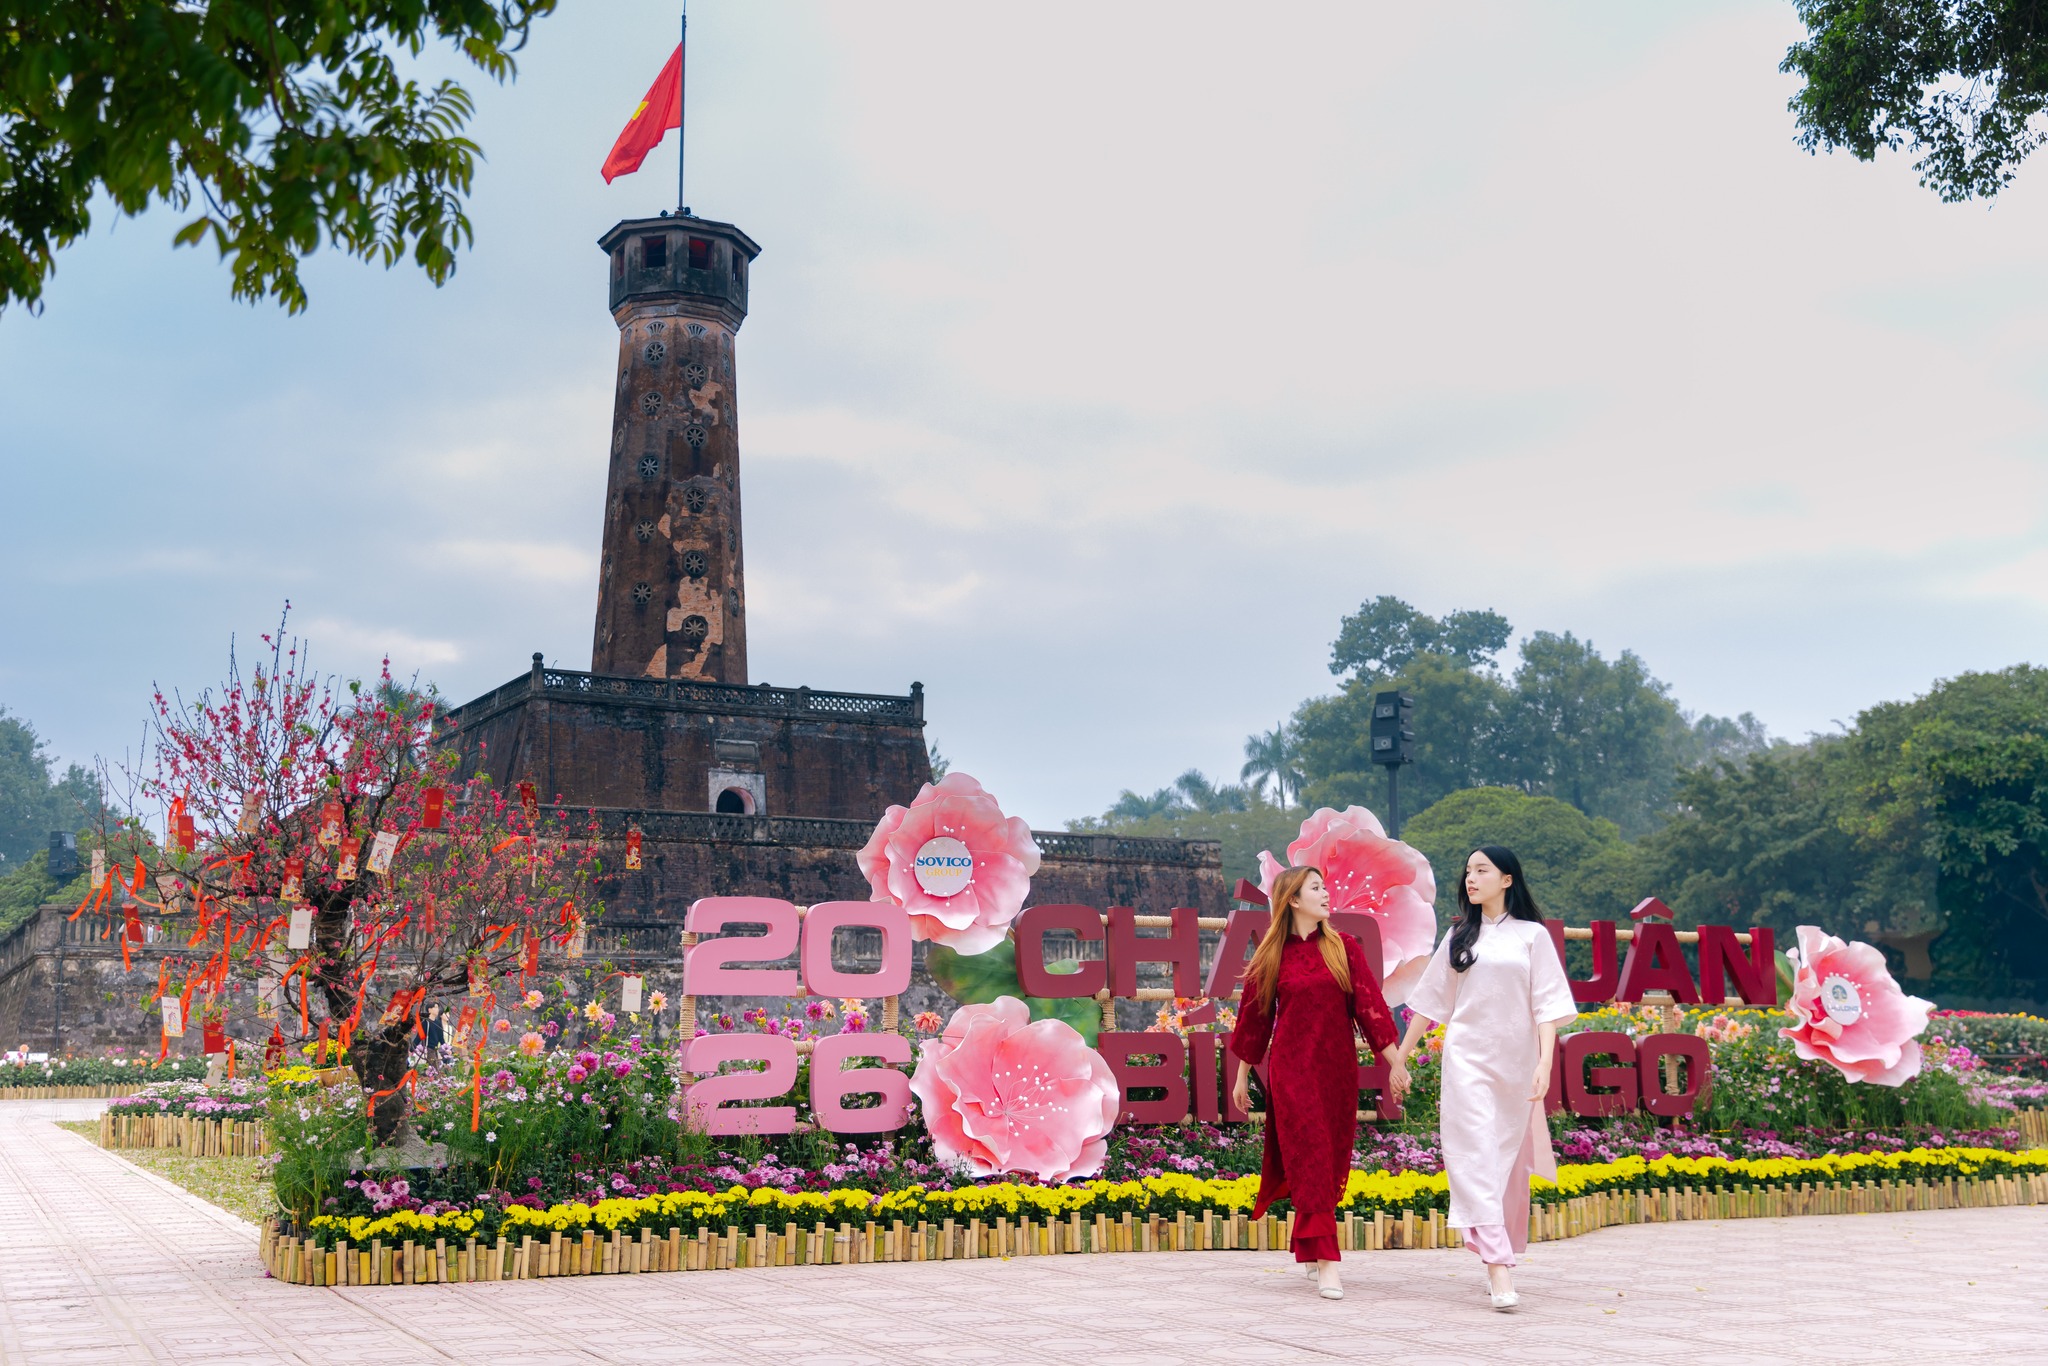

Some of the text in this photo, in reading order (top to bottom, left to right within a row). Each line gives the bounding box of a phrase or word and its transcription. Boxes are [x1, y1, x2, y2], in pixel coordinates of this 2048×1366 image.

[916, 856, 972, 867] SOVICO
[925, 868, 963, 877] GROUP
[683, 896, 913, 998] 20
[682, 1032, 913, 1135] 26
